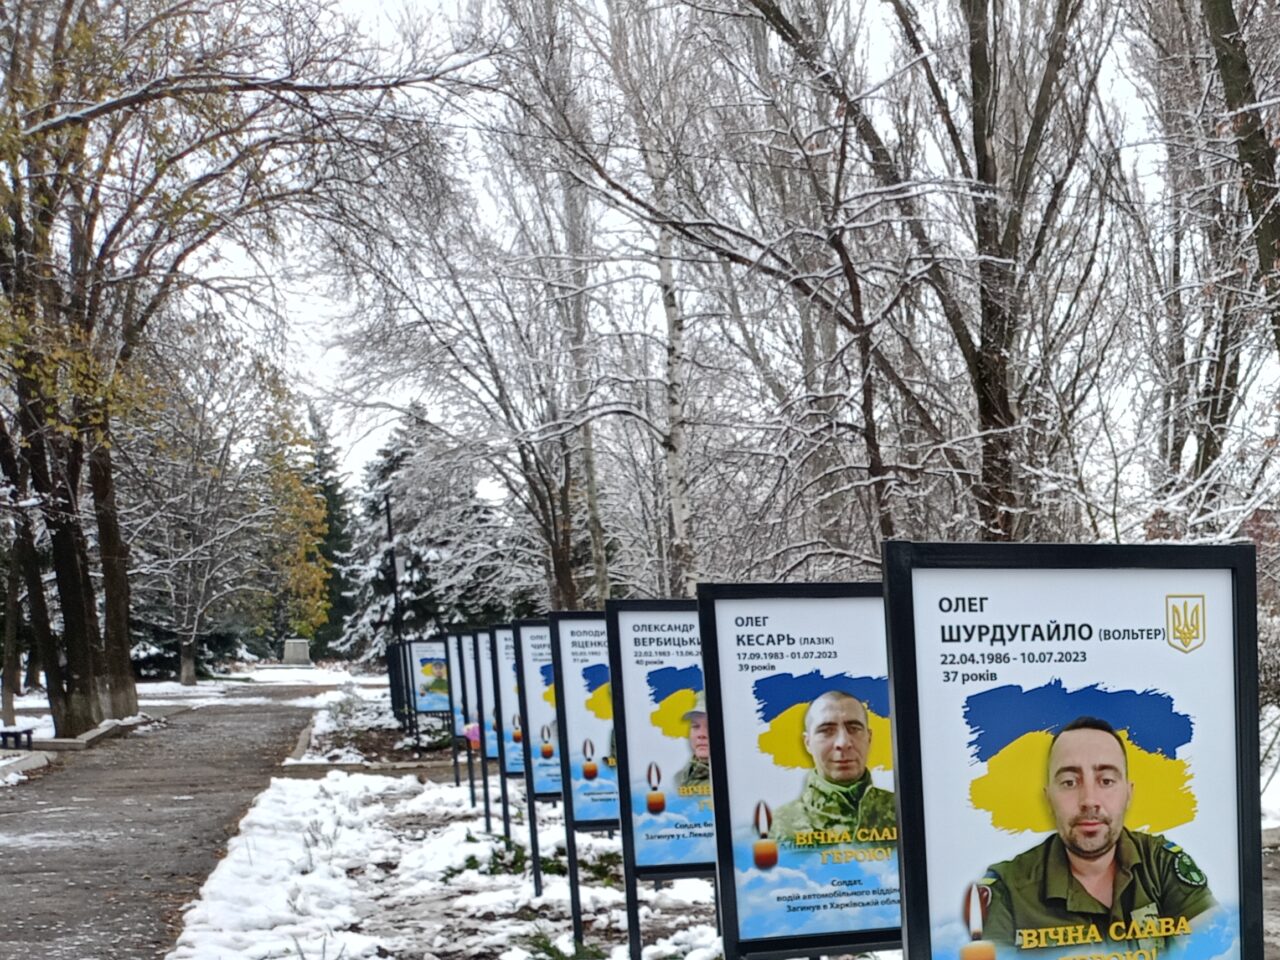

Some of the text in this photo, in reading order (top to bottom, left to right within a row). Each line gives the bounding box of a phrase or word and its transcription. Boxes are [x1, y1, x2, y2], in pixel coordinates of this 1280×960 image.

[938, 596, 988, 613] ОЛЕГ
[632, 624, 695, 633] ОЛЕКСАНДР
[735, 616, 769, 627] ОЛЕГ
[736, 633, 834, 647] КЕСАРЬ (ЛАЗІК)
[940, 620, 1166, 646] ШУРДУГАЙЛО (ВОЛЬТЕР)
[736, 652, 784, 661] 17.09.1983
[790, 651, 838, 660] 01.07.2023
[940, 652, 1011, 665] 22.04.1986
[1020, 651, 1087, 664] 10.07.2023
[738, 662, 776, 673] 39 років
[942, 669, 998, 685] 37 років
[795, 830, 852, 846] ВІЧНА
[821, 847, 892, 864] ГЕРОЮ!
[1021, 916, 1192, 949] ВІЧНА СЛАВА
